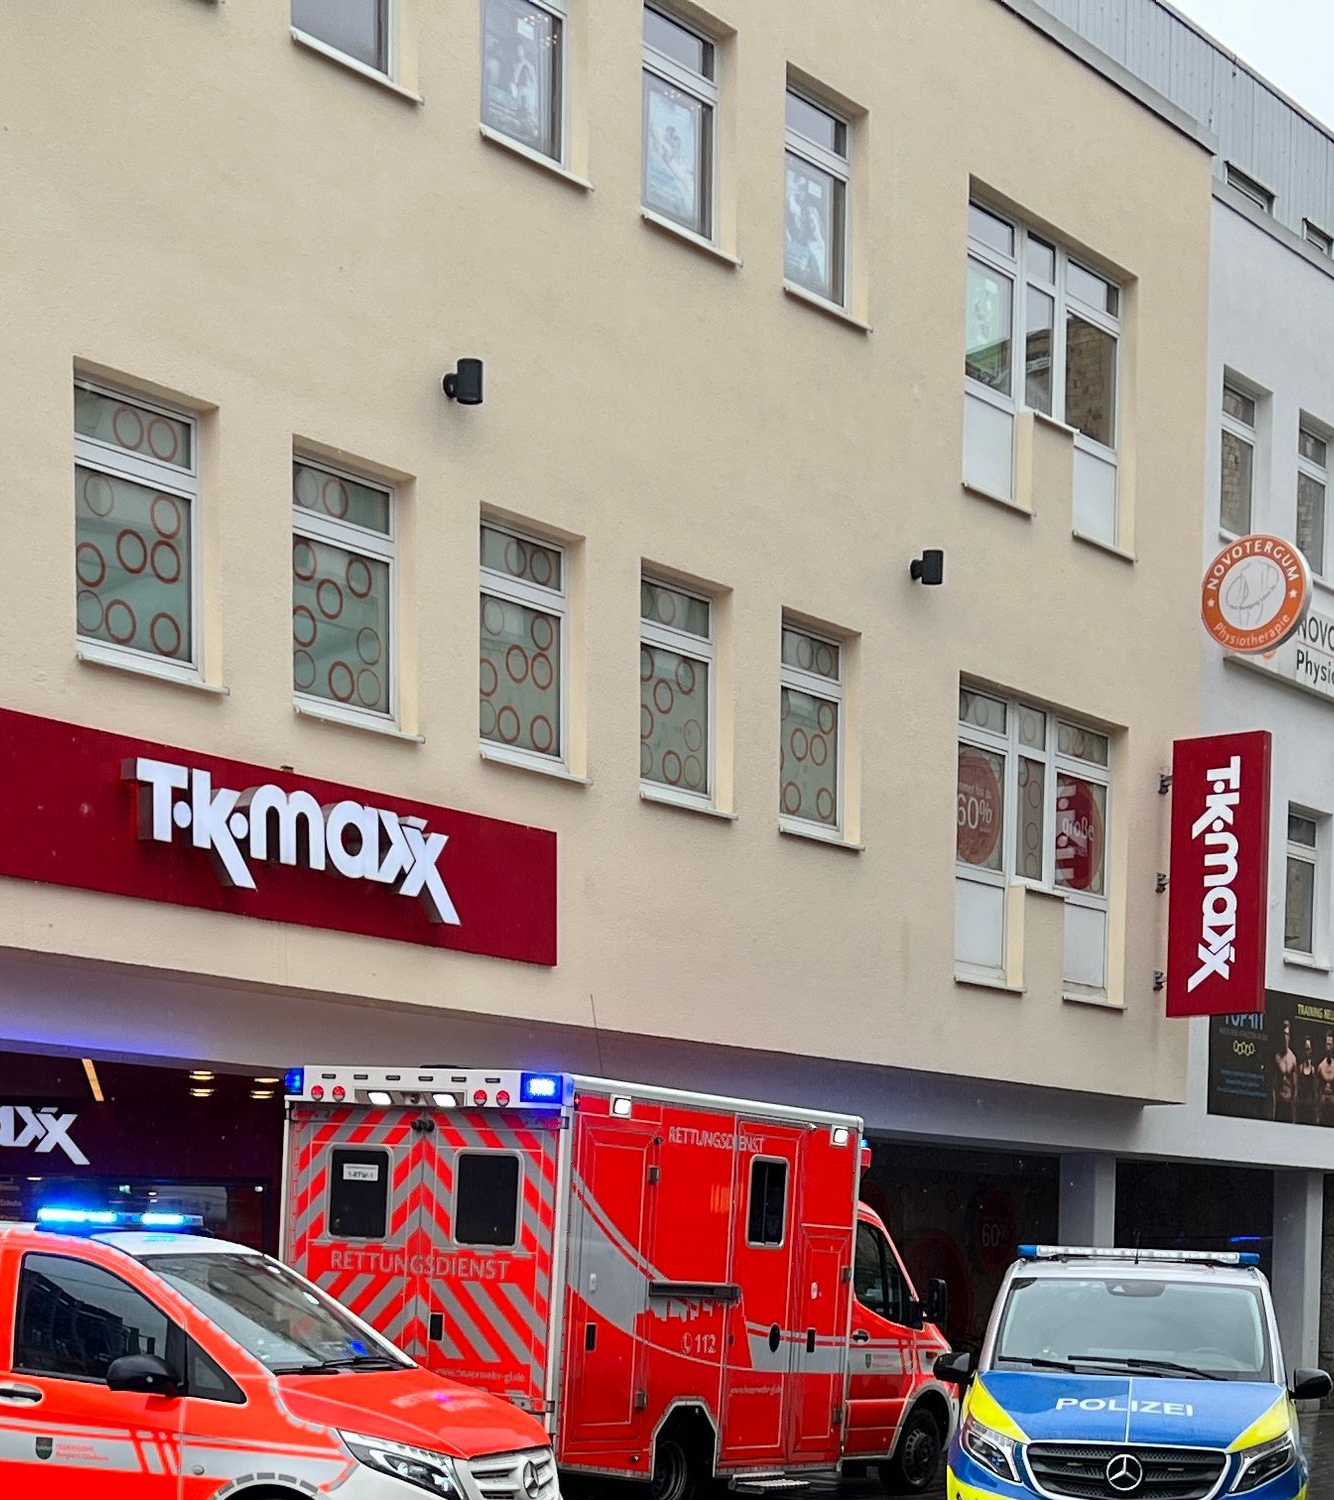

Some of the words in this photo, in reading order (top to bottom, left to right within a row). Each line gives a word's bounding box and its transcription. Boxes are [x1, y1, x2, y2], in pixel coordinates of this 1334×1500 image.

[1206, 538, 1300, 592] NOVOTERGUM
[1213, 612, 1291, 647] Physiotherapie
[330, 1250, 511, 1280] RETTUNGSDIENST
[694, 1333, 716, 1354] 112
[1055, 1397, 1194, 1418] POLIZEI
